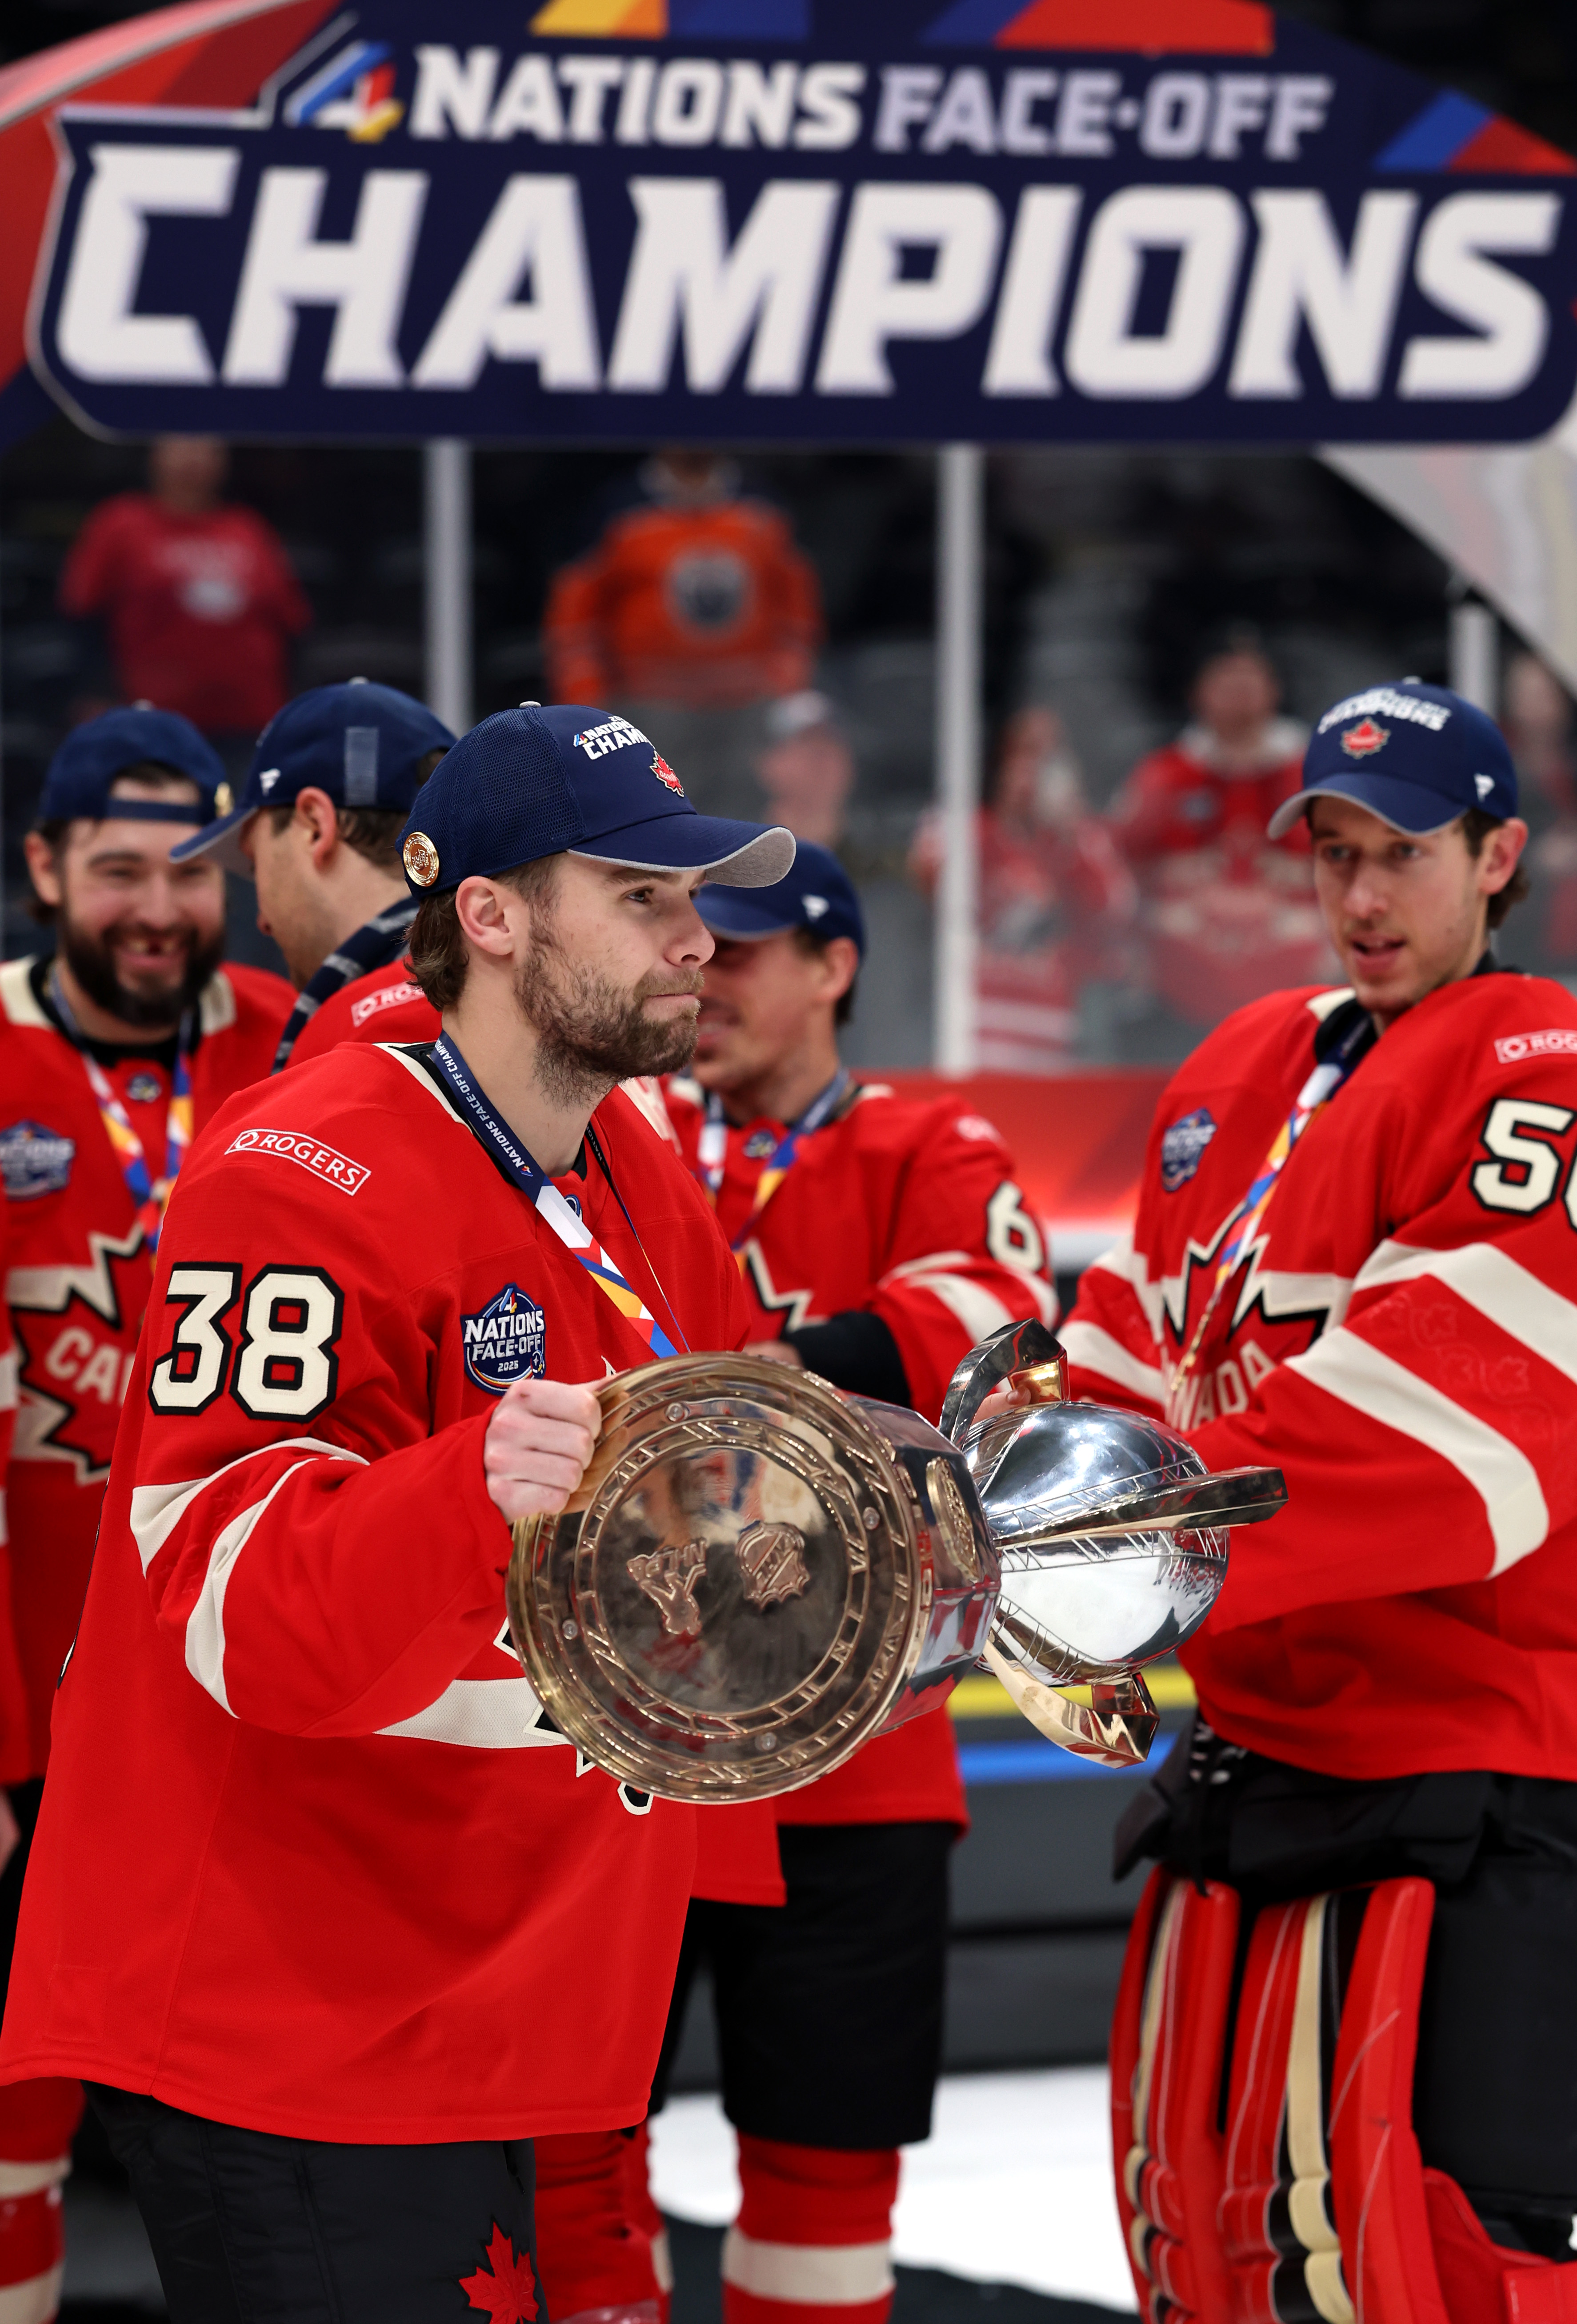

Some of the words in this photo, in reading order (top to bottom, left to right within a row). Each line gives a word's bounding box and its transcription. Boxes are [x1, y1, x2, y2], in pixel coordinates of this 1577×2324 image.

[409, 45, 865, 150] NATIONS
[56, 144, 1561, 401] CHAMPIONS
[258, 1134, 361, 1185] ROGERS
[485, 1120, 525, 1168] NATIONS
[149, 1263, 344, 1421] 38
[464, 1310, 544, 1343] NATIONS
[497, 1360, 519, 1372] 2025
